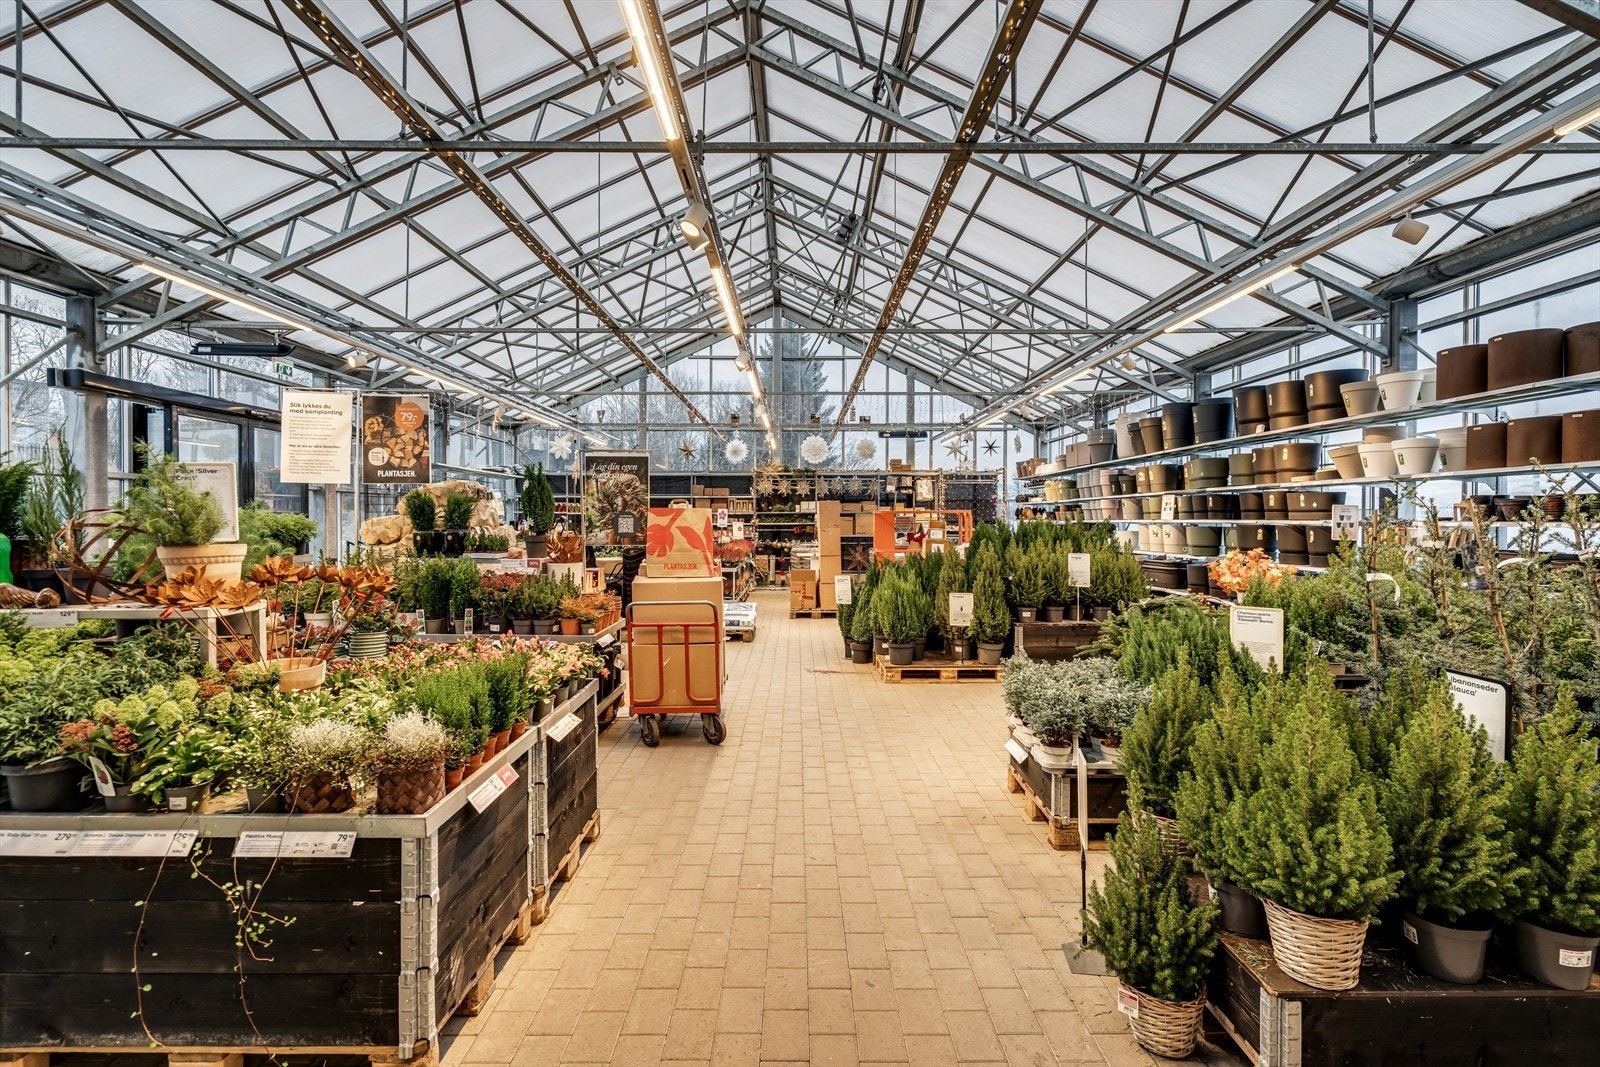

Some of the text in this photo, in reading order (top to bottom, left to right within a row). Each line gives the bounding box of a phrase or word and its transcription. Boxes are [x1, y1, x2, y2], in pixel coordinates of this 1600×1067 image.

[592, 463, 607, 472] Lag
[621, 464, 637, 472] egen
[1450, 676, 1499, 693] ibanonseder
[337, 834, 348, 842] 79
